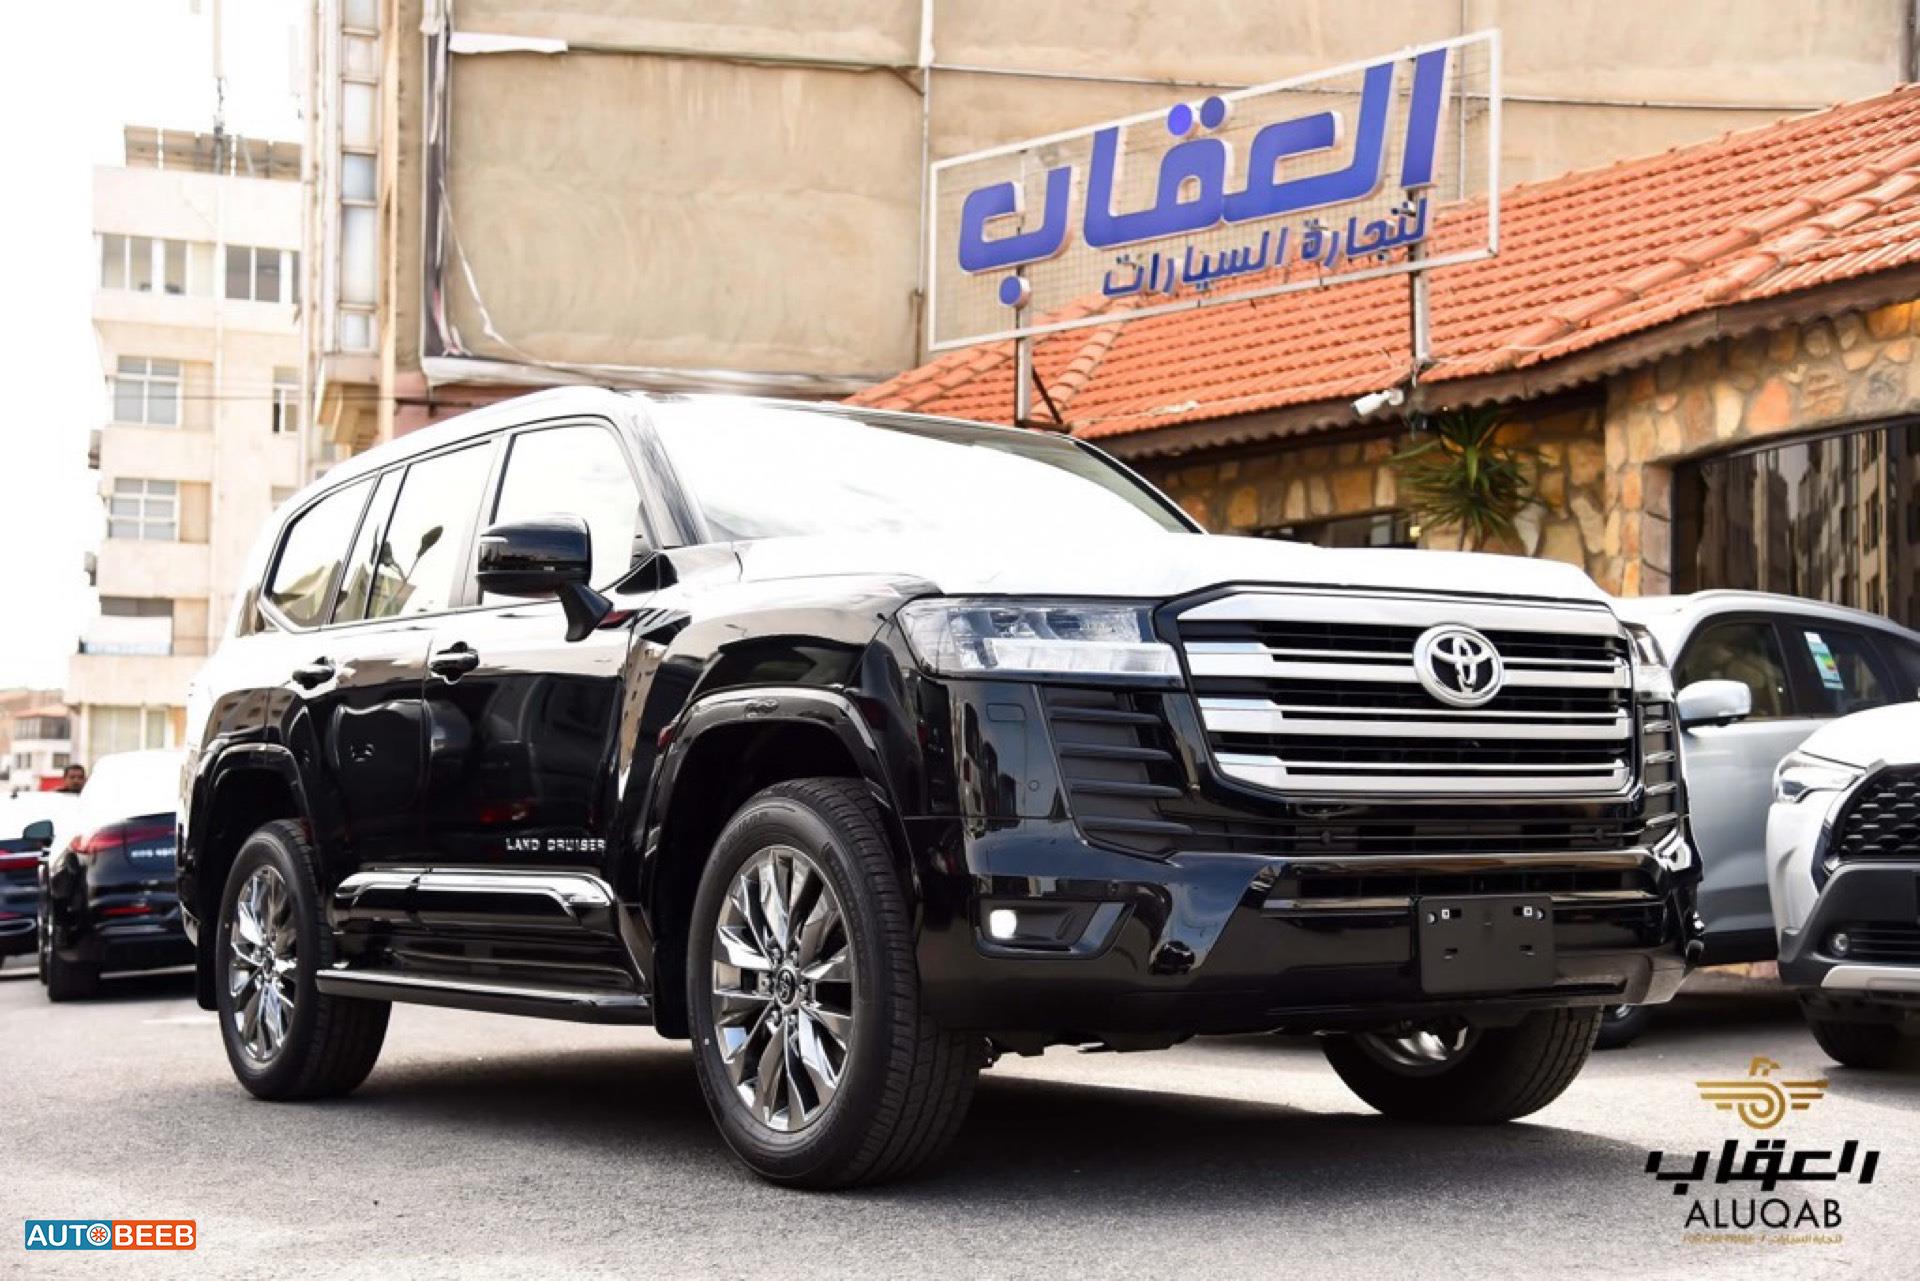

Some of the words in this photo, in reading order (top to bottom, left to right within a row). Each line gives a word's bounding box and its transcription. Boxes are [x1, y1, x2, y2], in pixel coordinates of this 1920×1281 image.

[958, 47, 1450, 307] العقاب
[1102, 226, 1289, 297] السيارات
[1300, 197, 1428, 269] لتجارة
[505, 837, 540, 851] LAND
[546, 838, 606, 853] CRUISER
